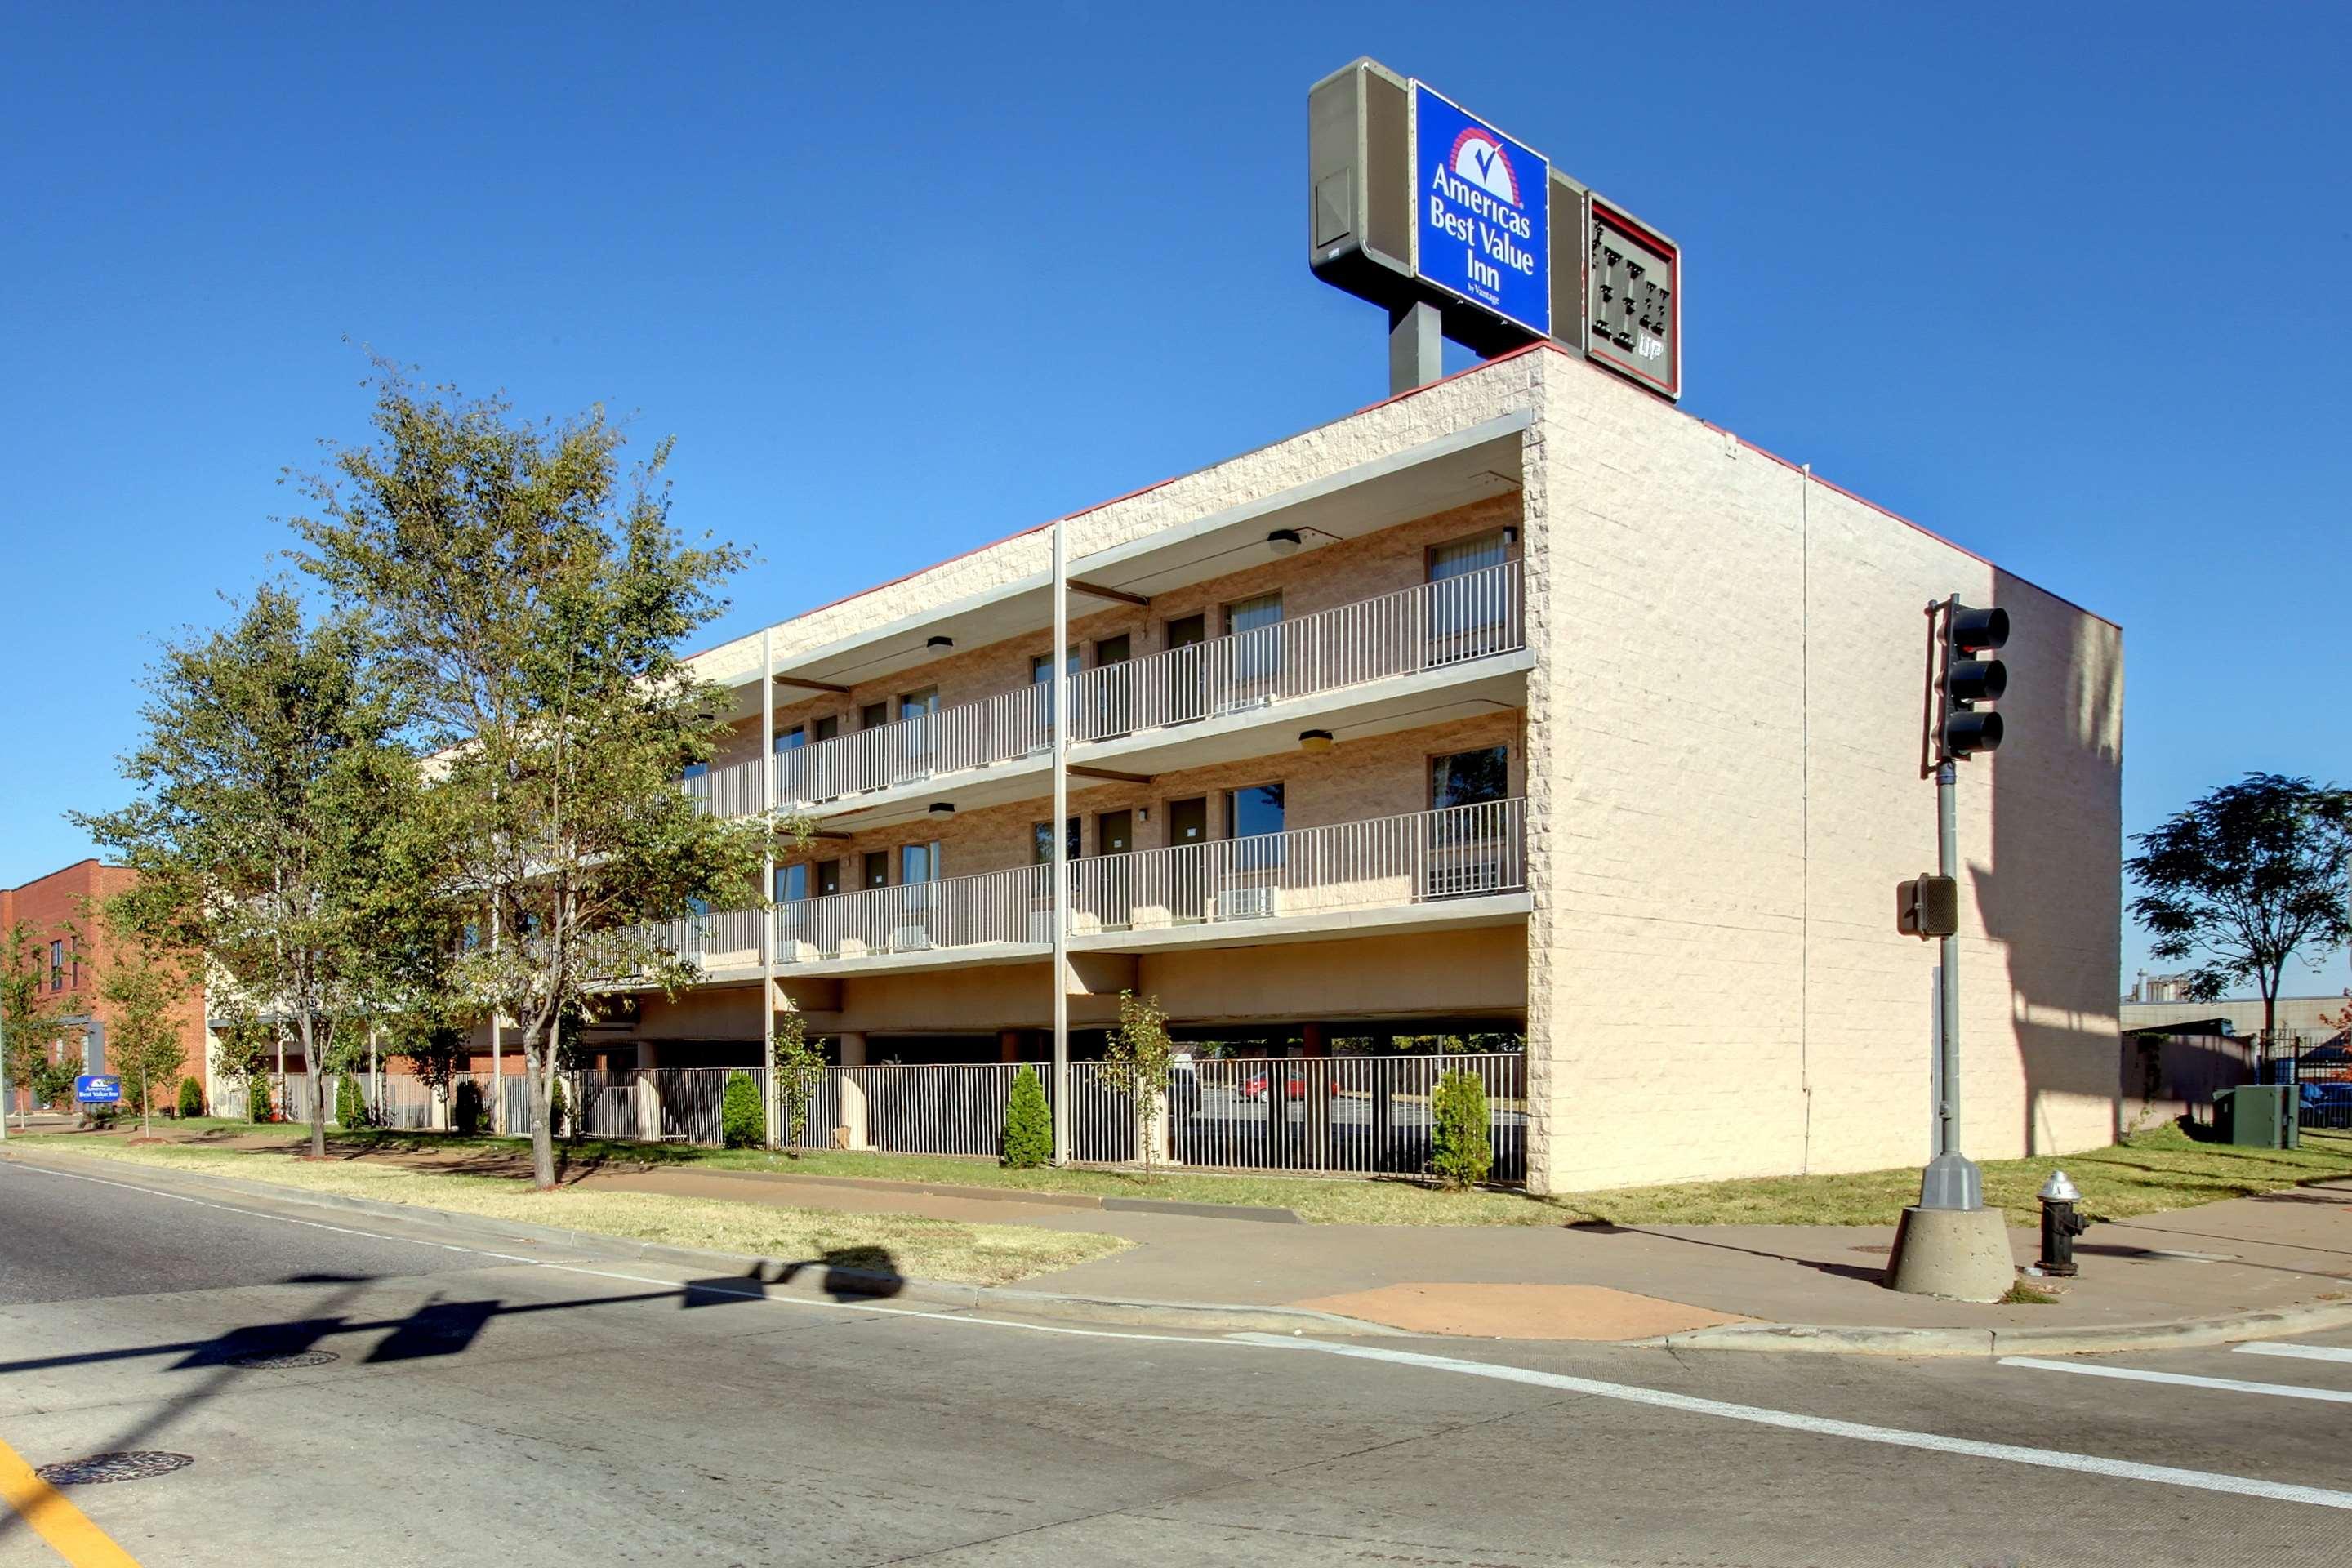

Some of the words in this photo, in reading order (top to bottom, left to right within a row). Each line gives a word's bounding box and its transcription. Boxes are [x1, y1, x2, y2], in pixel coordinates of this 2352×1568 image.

[1431, 195, 1475, 247] Best
[1480, 221, 1534, 276] Value
[1432, 163, 1530, 239] Americas
[1468, 248, 1499, 292] Inn
